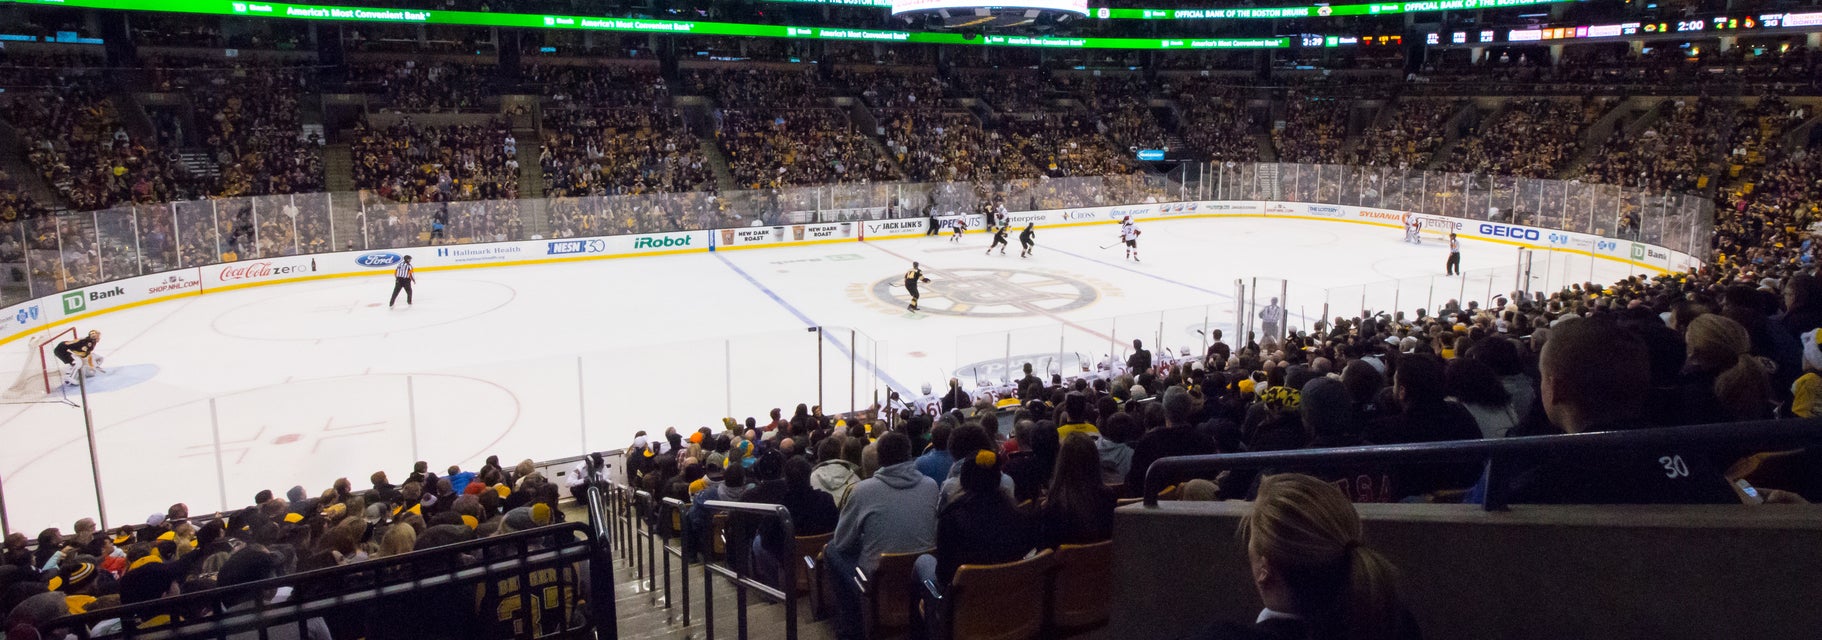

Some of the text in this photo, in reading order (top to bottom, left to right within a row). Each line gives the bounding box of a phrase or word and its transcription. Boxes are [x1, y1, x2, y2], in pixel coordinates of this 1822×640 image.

[287, 6, 330, 17] America's
[331, 10, 354, 18] Most
[355, 10, 404, 20] Convenient
[1174, 8, 1308, 18] OFFICIAL BANK OF THE BOSTON BRUINS
[581, 18, 614, 28] America's
[616, 20, 634, 29] Most
[634, 21, 672, 30] Convenient
[1659, 24, 1667, 32] 2
[1678, 20, 1704, 32] 2:00
[1729, 19, 1738, 28] 2
[820, 29, 846, 38] America's
[1302, 38, 1323, 46] 3:39
[1359, 210, 1400, 221] SYLVANIA
[882, 220, 922, 230] JACK LINK'S
[1480, 223, 1540, 241] GEICO
[554, 241, 582, 254] NESN
[634, 234, 692, 249] iRobot
[453, 248, 491, 257] Hallmark
[494, 245, 521, 254] Health
[365, 254, 394, 266] Ford
[273, 264, 307, 275] zero
[90, 286, 124, 302] Bank
[1659, 454, 1690, 479] 30
